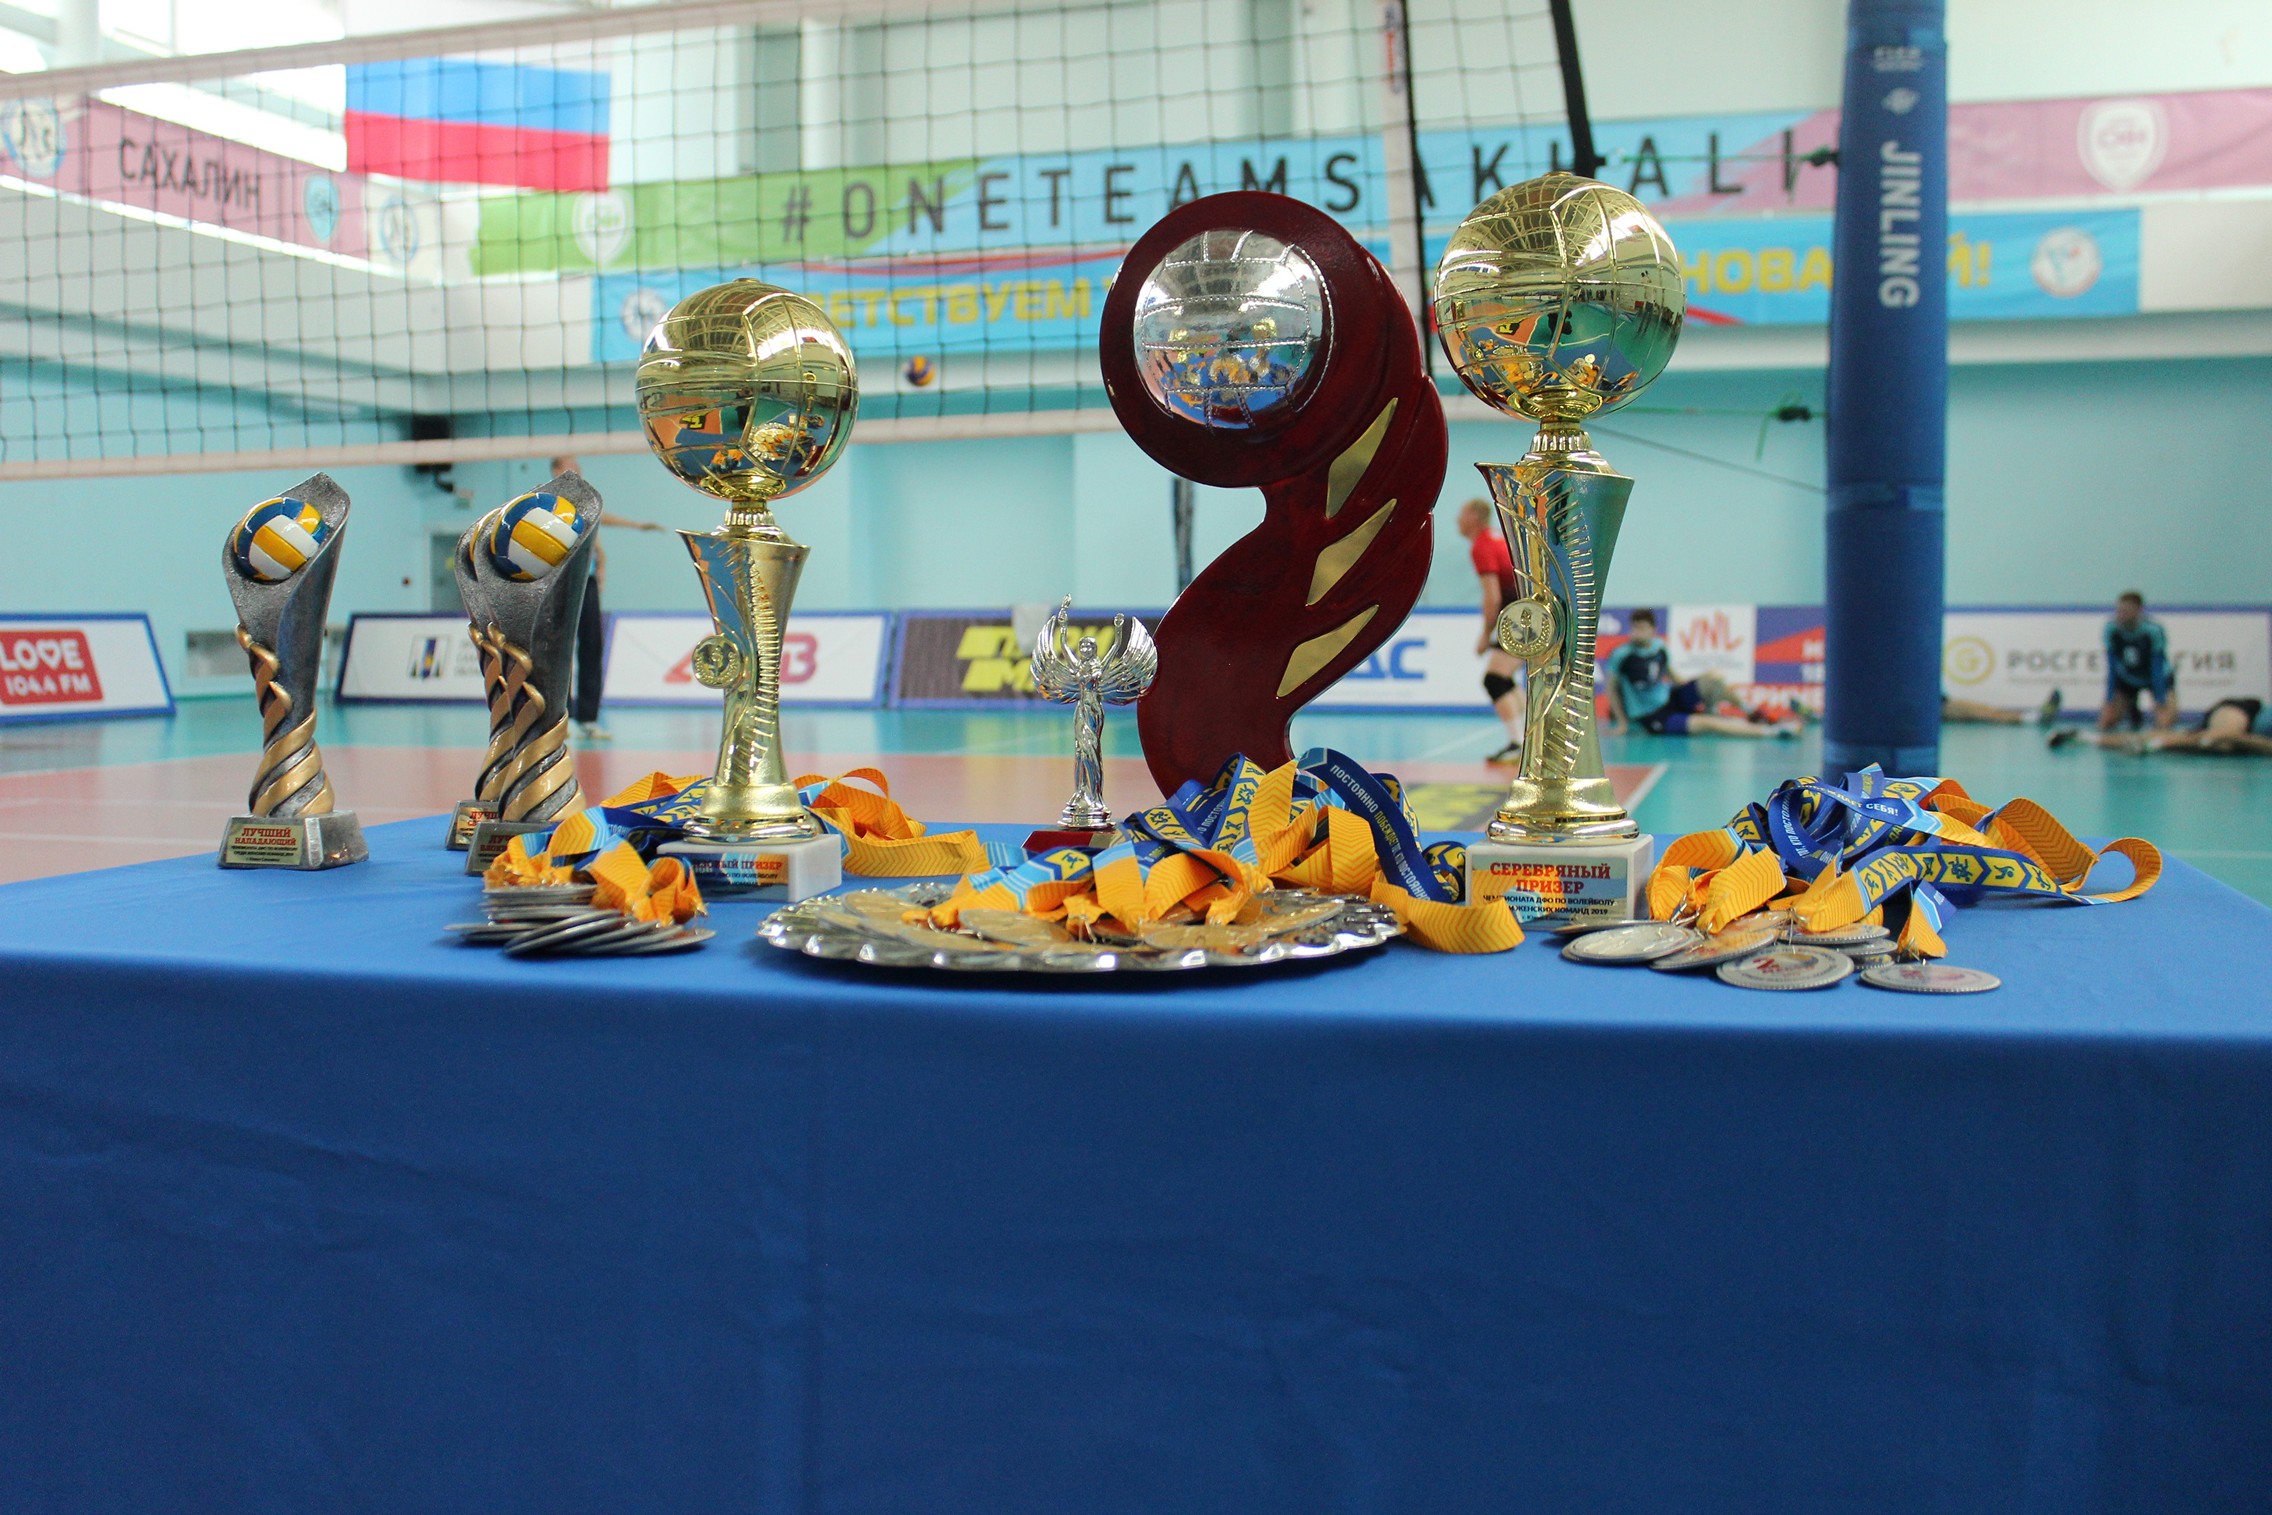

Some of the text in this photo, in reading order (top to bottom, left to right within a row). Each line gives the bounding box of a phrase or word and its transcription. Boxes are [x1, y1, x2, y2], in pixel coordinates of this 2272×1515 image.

[119, 138, 261, 208] САХАЛИН
[1877, 140, 1922, 308] JINLING
[59, 673, 93, 694] FM
[1330, 764, 1379, 813] ПОСТОЯННО
[1866, 803, 1899, 816] СЕБЯ!
[241, 827, 292, 838] ЛУЧШИЙ
[740, 860, 783, 871] ПРИЗЕР
[1490, 862, 1611, 880] СЕРЕБРЯНЫЙ
[1515, 879, 1585, 895] ПРИЗЕР
[1483, 894, 1615, 907] ЧЕМИОНАТА ДФО ПО ВОЛЕЙБОЛУ
[1514, 905, 1553, 914] ЖЕНСКИХ
[1554, 906, 1590, 916] КОМАНД
[1591, 908, 1608, 916] 2019
